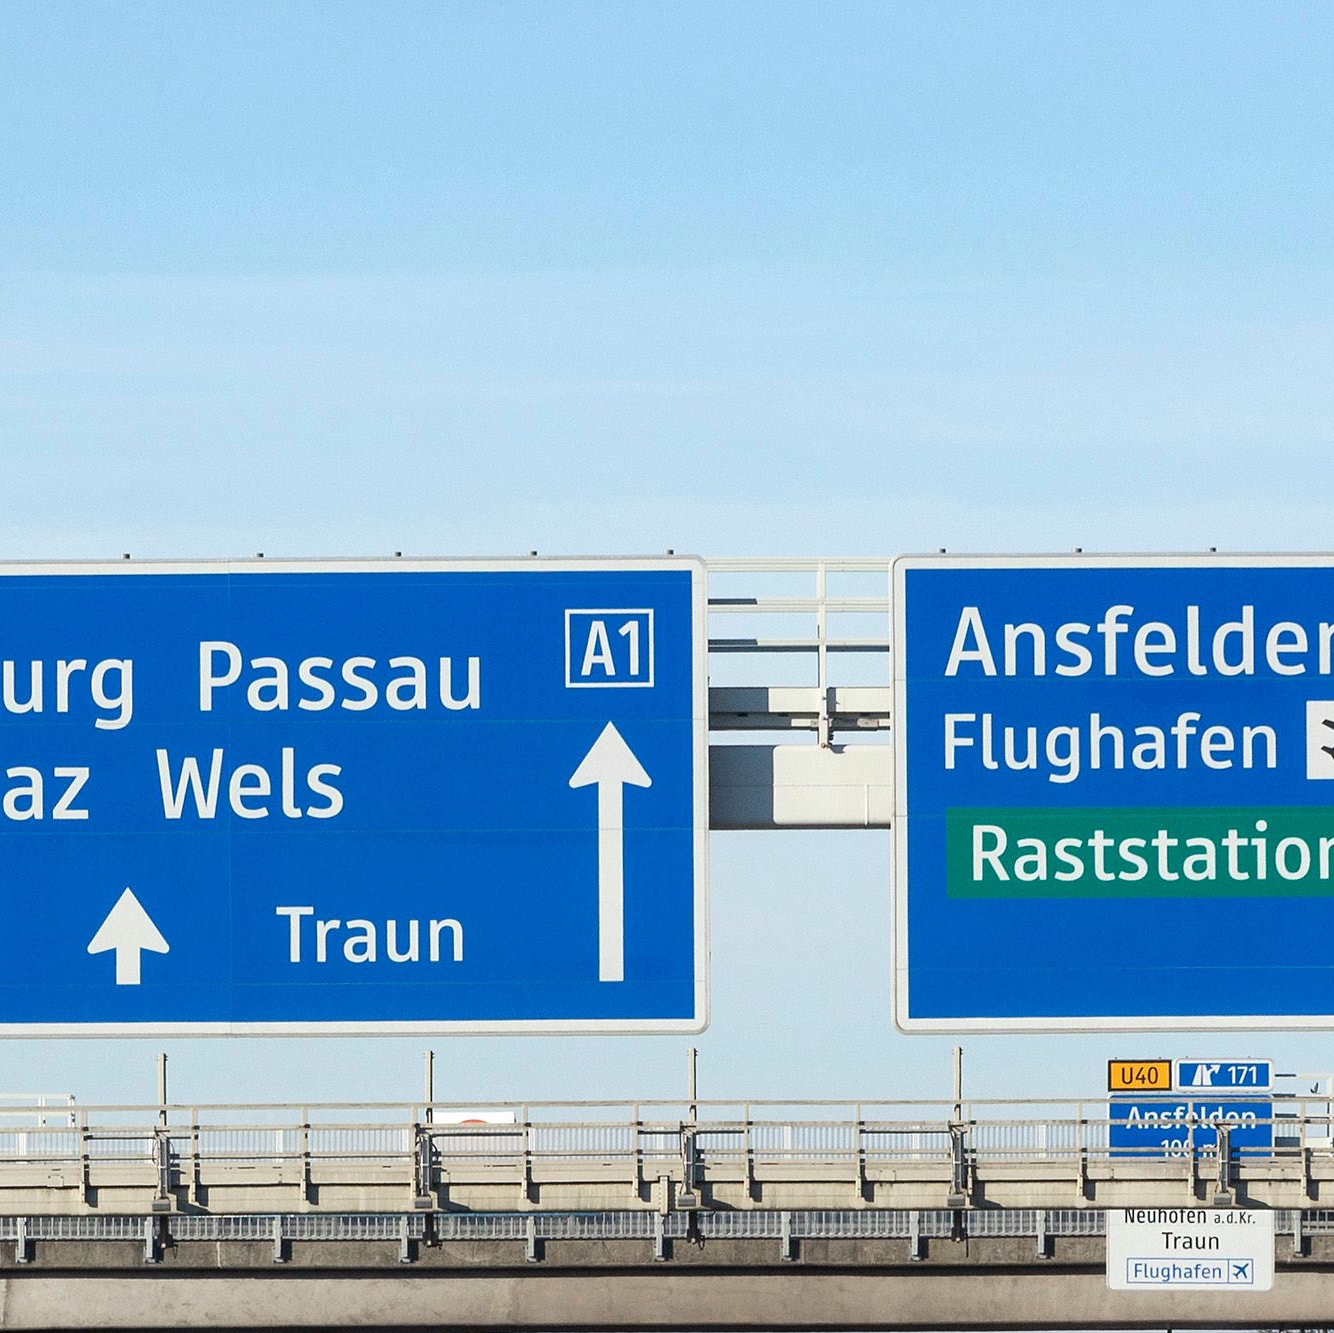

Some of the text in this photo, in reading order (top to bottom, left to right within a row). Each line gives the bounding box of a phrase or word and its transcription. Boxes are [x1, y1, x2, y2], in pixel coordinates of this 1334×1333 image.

[582, 620, 643, 676] A1
[199, 641, 480, 712] Passau
[944, 711, 1277, 784] Flughafen
[156, 747, 344, 819] Wels
[275, 906, 464, 963] Traun
[1121, 1066, 1159, 1085] U40
[1227, 1065, 1258, 1085] 171
[1161, 1231, 1219, 1250] Traun
[1134, 1263, 1222, 1282] Flughafen
